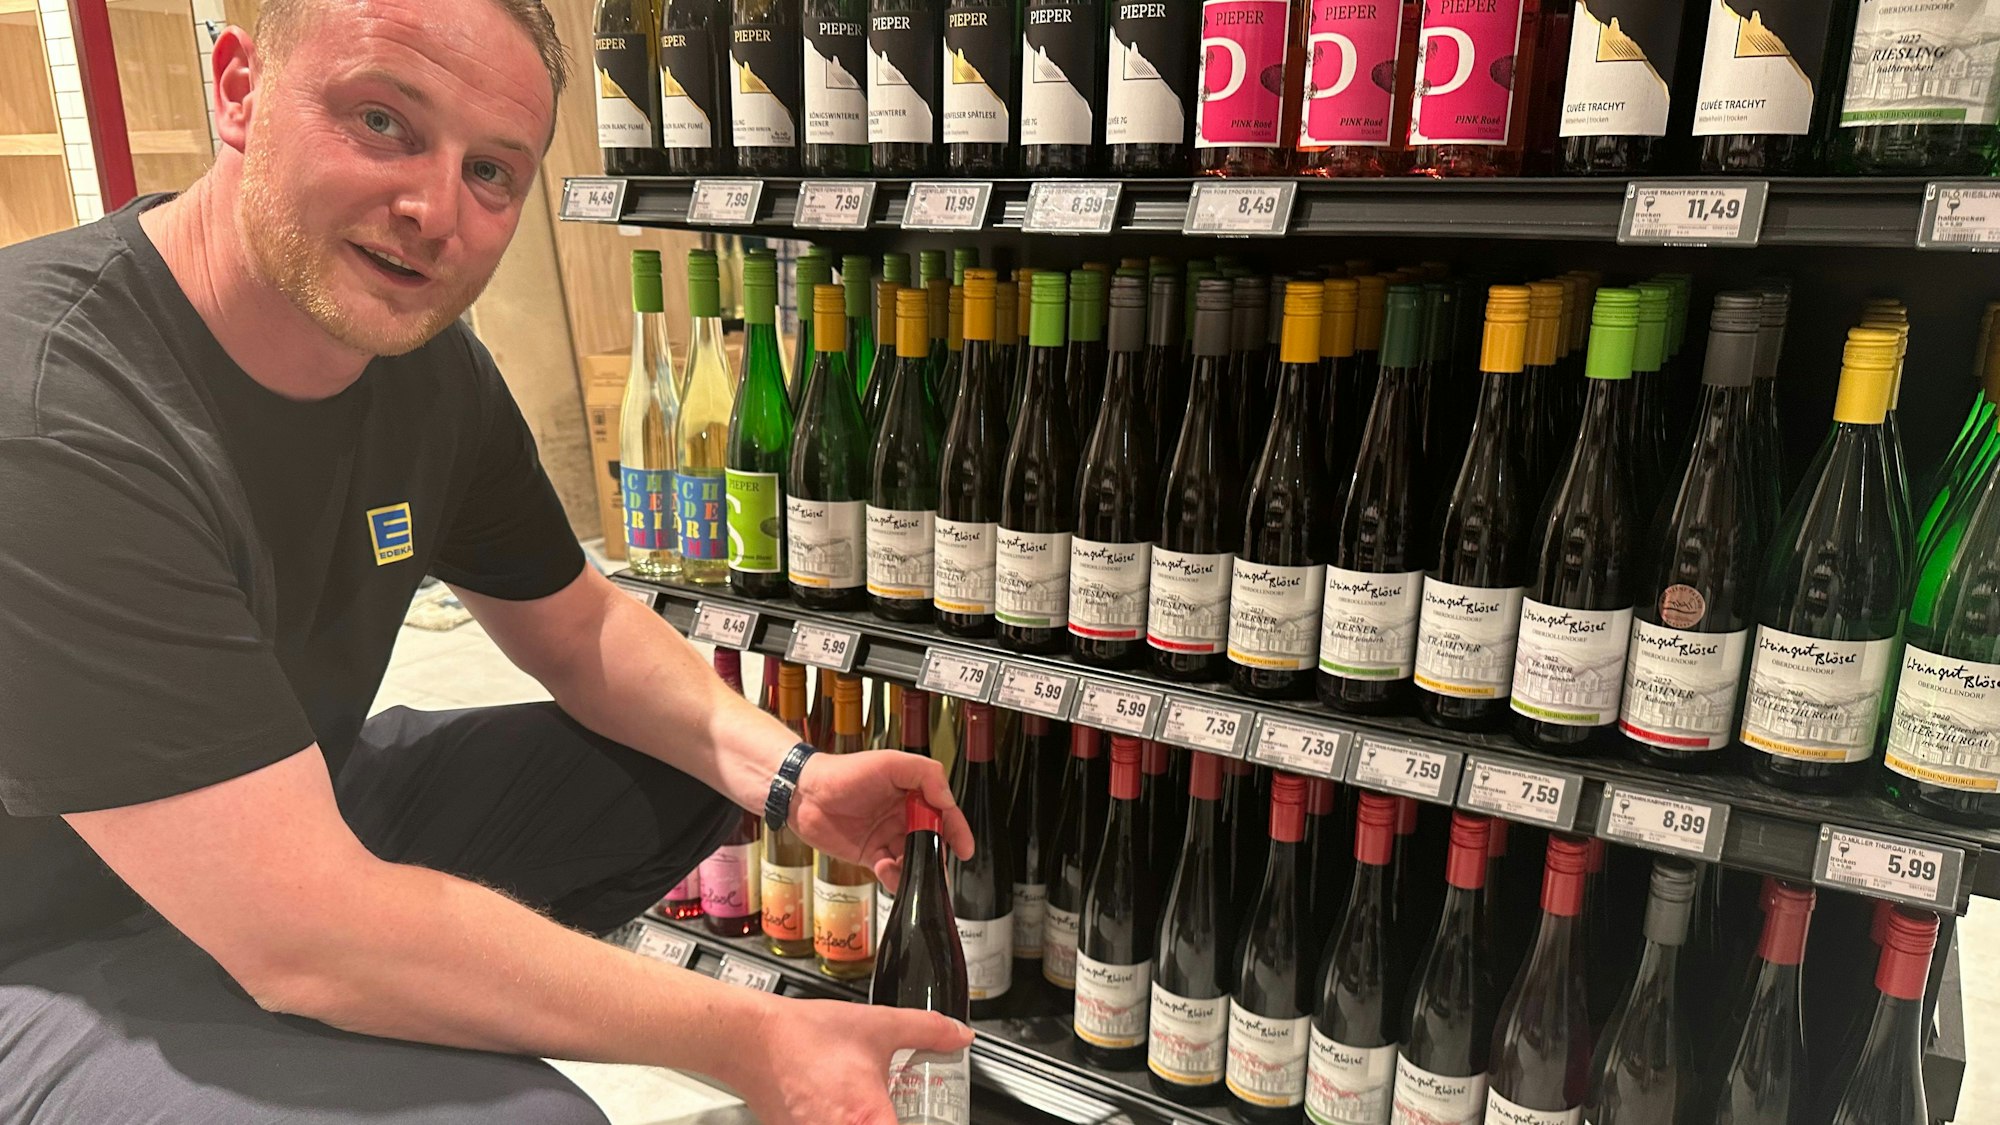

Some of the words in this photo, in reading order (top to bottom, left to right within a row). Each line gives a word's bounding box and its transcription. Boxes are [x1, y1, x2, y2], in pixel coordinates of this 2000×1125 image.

[1120, 3, 1167, 20] PIEPER
[1324, 5, 1378, 22] PIEPER
[1441, 0, 1496, 14] PIEPER
[872, 16, 911, 31] PIEPER
[949, 12, 988, 28] PIEPER
[1030, 8, 1073, 25] PIEPER
[1215, 9, 1266, 26] PIEPER
[734, 29, 772, 43] PIEPER
[819, 21, 862, 36] PIEPER
[1872, 46, 1947, 61] RIESLING
[1566, 102, 1587, 114] CUVÉE
[1588, 101, 1626, 113] TRACHYT
[1700, 100, 1723, 111] CUVÉE
[1725, 99, 1767, 110] TRACHYT
[967, 110, 998, 120] SPÄTLESE
[1340, 117, 1361, 127] PINK
[1363, 117, 1384, 128] Rosé
[1455, 114, 1478, 125] PINK
[1479, 114, 1501, 125] Rosé
[1231, 119, 1251, 129] PINK
[588, 191, 614, 206] 14,49
[725, 192, 749, 208] 7,99
[834, 194, 861, 210] 7,99
[945, 195, 977, 212] 11,99
[1072, 197, 1103, 213] 8,99
[1237, 196, 1275, 214] 8,49
[1687, 198, 1740, 221] 11,49
[380, 545, 412, 560] EDEKA
[1020, 541, 1048, 554] Blöser
[1106, 552, 1136, 565] Blöser
[1183, 564, 1214, 577] Blöser
[1268, 576, 1301, 589] Blöser
[1078, 587, 1120, 601] RIESLING
[1369, 586, 1402, 600] Blöser
[1155, 598, 1195, 612] RIESLING
[1466, 601, 1500, 614] Blöser
[722, 617, 746, 634] 8,49
[1238, 611, 1277, 626] KERNER
[1523, 607, 1573, 628] Weingut
[1568, 619, 1606, 635] Blöser
[1335, 620, 1378, 635] KERNER
[822, 637, 846, 655] 5,99
[1427, 635, 1482, 653] TRAMINER
[1633, 628, 1683, 650] Weingut
[1679, 642, 1718, 656] Blöser
[1641, 649, 1698, 666] OBERDOLLENDORF
[1759, 636, 1819, 659] Weingut
[1814, 651, 1857, 666] Blöser
[958, 665, 985, 684] 7,79
[1531, 659, 1574, 674] TRAMINER
[1771, 658, 1836, 676] OBERDOLLENDORF
[1906, 655, 1969, 680] Weingut
[1033, 681, 1062, 701] 5,99
[1634, 678, 1695, 700] TRAMINER
[1917, 680, 1986, 700] OBERDOLLENDORF
[1115, 698, 1146, 718] 5,99
[1751, 695, 1840, 721] MÜLLER-THURGAU
[1204, 716, 1236, 737] 7,39
[1897, 717, 1993, 748] MÜLLER-THURGAU
[1300, 735, 1335, 757] 7,39
[1405, 757, 1441, 780] 7,59
[1917, 767, 1978, 786] SIEBENGEBIRGE
[1520, 780, 1560, 805] 7,59
[1662, 809, 1706, 834] 8,99
[1887, 853, 1937, 882] 5,99
